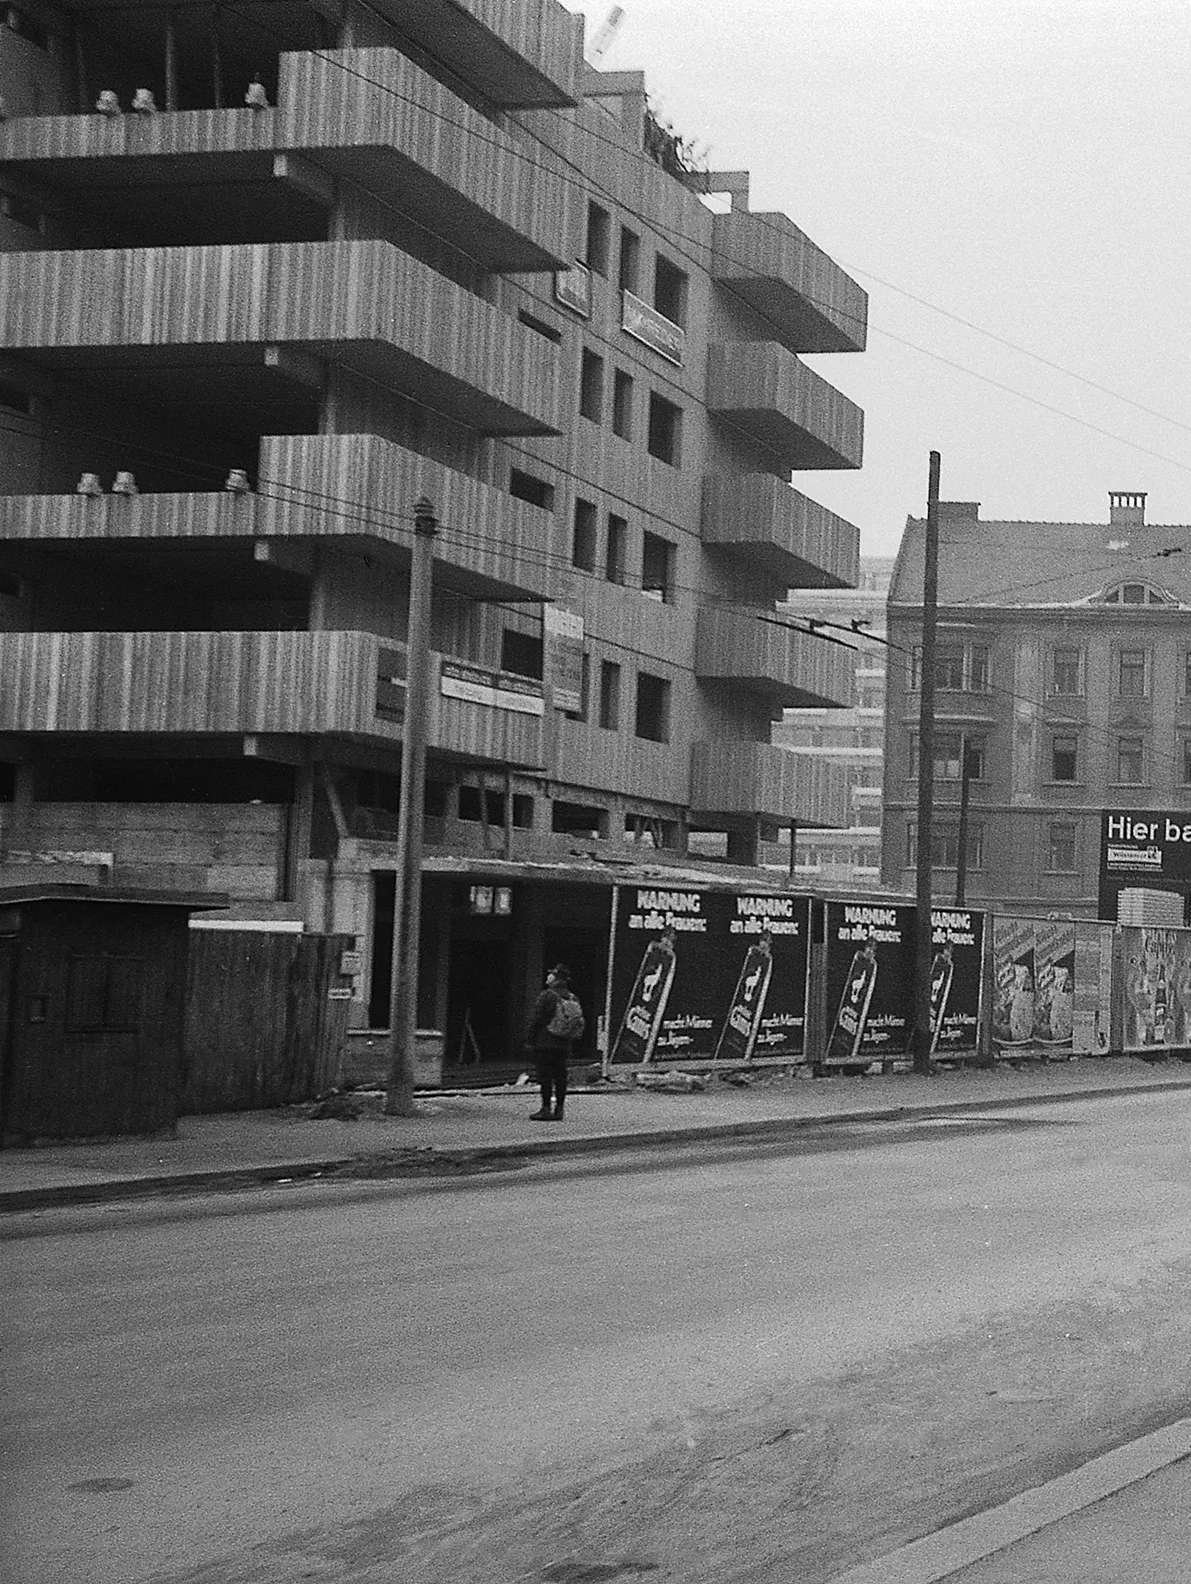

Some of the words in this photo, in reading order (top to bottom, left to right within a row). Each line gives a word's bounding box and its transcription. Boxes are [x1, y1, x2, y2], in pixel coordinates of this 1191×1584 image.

[1108, 815, 1159, 840] Hier
[637, 890, 700, 913] WARNUNG
[737, 897, 793, 917] WARNUNG
[845, 906, 897, 926] WARNUNG
